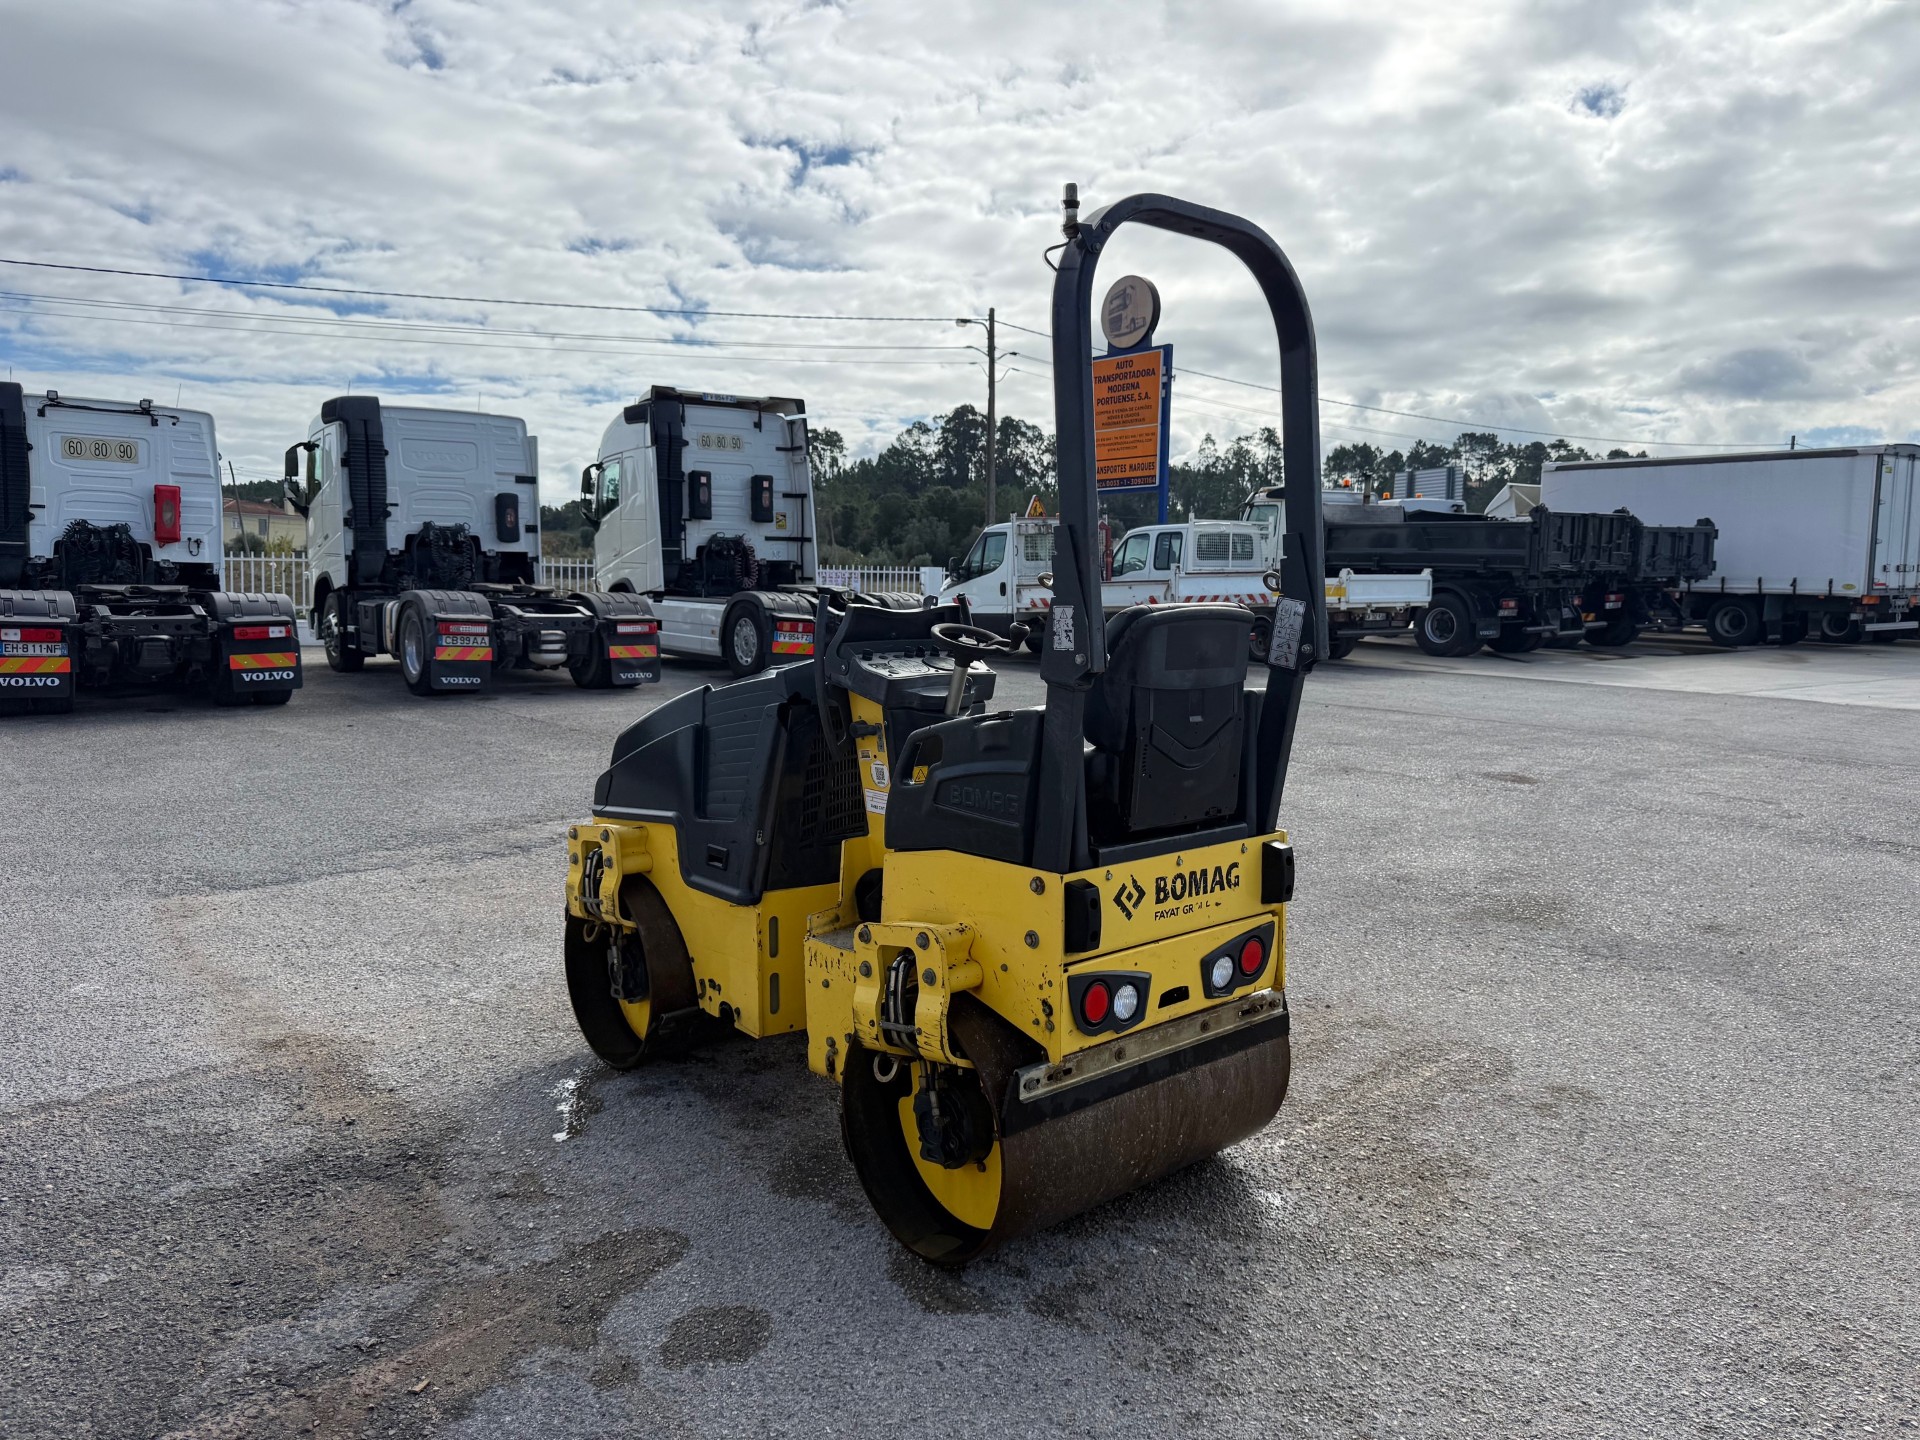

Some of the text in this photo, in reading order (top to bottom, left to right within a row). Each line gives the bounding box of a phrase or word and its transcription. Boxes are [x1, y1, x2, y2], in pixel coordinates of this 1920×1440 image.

[1115, 360, 1134, 370] AUTO
[1094, 368, 1156, 384] TRANSPORTADORA
[1107, 381, 1140, 394] MODERNA
[1096, 392, 1152, 406] PORTUENSE, S.A.
[702, 435, 741, 449] 60 80 90
[68, 440, 133, 459] 60 80 90
[1097, 462, 1155, 474] ANSPORTES MARQUES
[0, 677, 60, 687] VOLVO
[241, 670, 295, 682] VOLVO
[619, 672, 653, 680] VOLVO
[951, 785, 1021, 817] BOMAG
[1154, 861, 1240, 906] BOMAG
[1154, 906, 1181, 921] FAYAT
